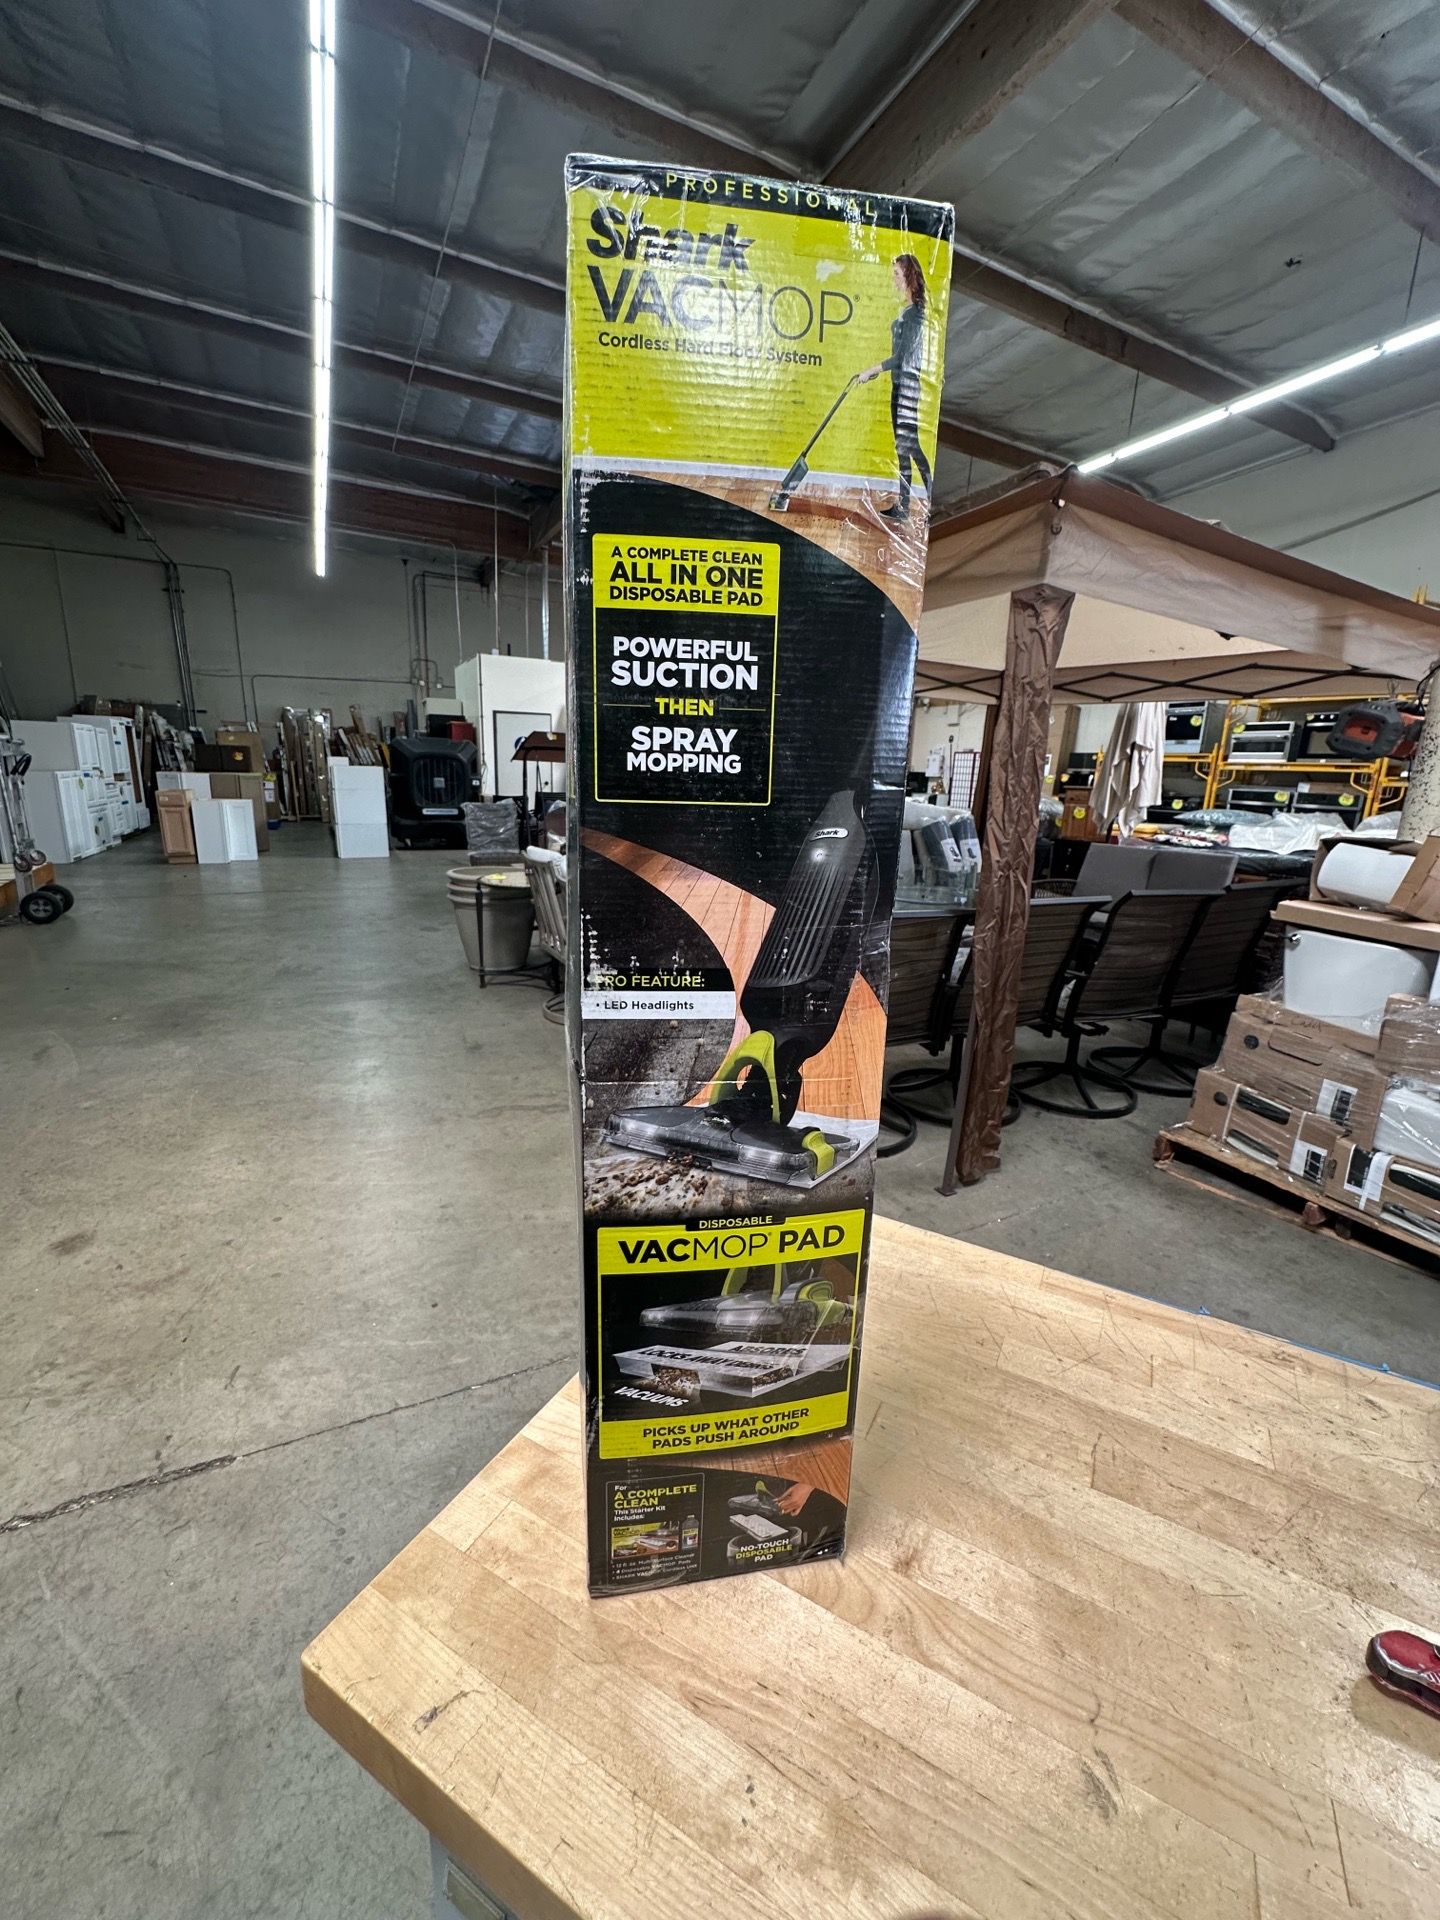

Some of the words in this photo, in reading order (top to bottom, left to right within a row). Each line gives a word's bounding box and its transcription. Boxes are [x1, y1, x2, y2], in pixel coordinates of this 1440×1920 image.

[586, 206, 756, 272] Shark
[598, 331, 670, 351] Cordless
[675, 338, 714, 355] Hard
[766, 347, 822, 367] System
[611, 546, 623, 558] A
[627, 546, 708, 562] COMPLETE
[712, 551, 763, 565] CLEAN
[610, 561, 663, 584] ALL
[670, 564, 698, 586] IN
[705, 565, 763, 589] ONE
[610, 586, 723, 604] DISPOSABLE
[727, 592, 763, 606] PAD
[613, 636, 758, 662] POWERFUL
[611, 660, 758, 690] SUCTION
[655, 698, 714, 716] THEN
[631, 725, 738, 753] SPRAY
[627, 752, 742, 774] MOPPING
[631, 975, 706, 987] FEATURE:
[604, 1001, 628, 1010] LED
[631, 1000, 694, 1011] Headlights
[699, 1215, 773, 1229] DISPOSABLE
[779, 1224, 845, 1253] PAD
[613, 1386, 690, 1408] VACUUMS
[643, 1425, 687, 1438] PICKS
[690, 1422, 711, 1433] UP
[714, 1416, 759, 1431] WHAT
[762, 1408, 809, 1424] OTHER
[652, 1436, 692, 1449] PADS
[695, 1431, 734, 1445] PUSH
[738, 1421, 800, 1440] AROUND
[614, 1491, 625, 1500] A
[627, 1484, 698, 1499] COMPLETE
[614, 1497, 659, 1509] CLEAN
[629, 1506, 654, 1514] Starter
[735, 1544, 793, 1560] DISPOSABLE
[740, 1538, 790, 1553] NO-TOUCH
[754, 1554, 774, 1563] PAD
